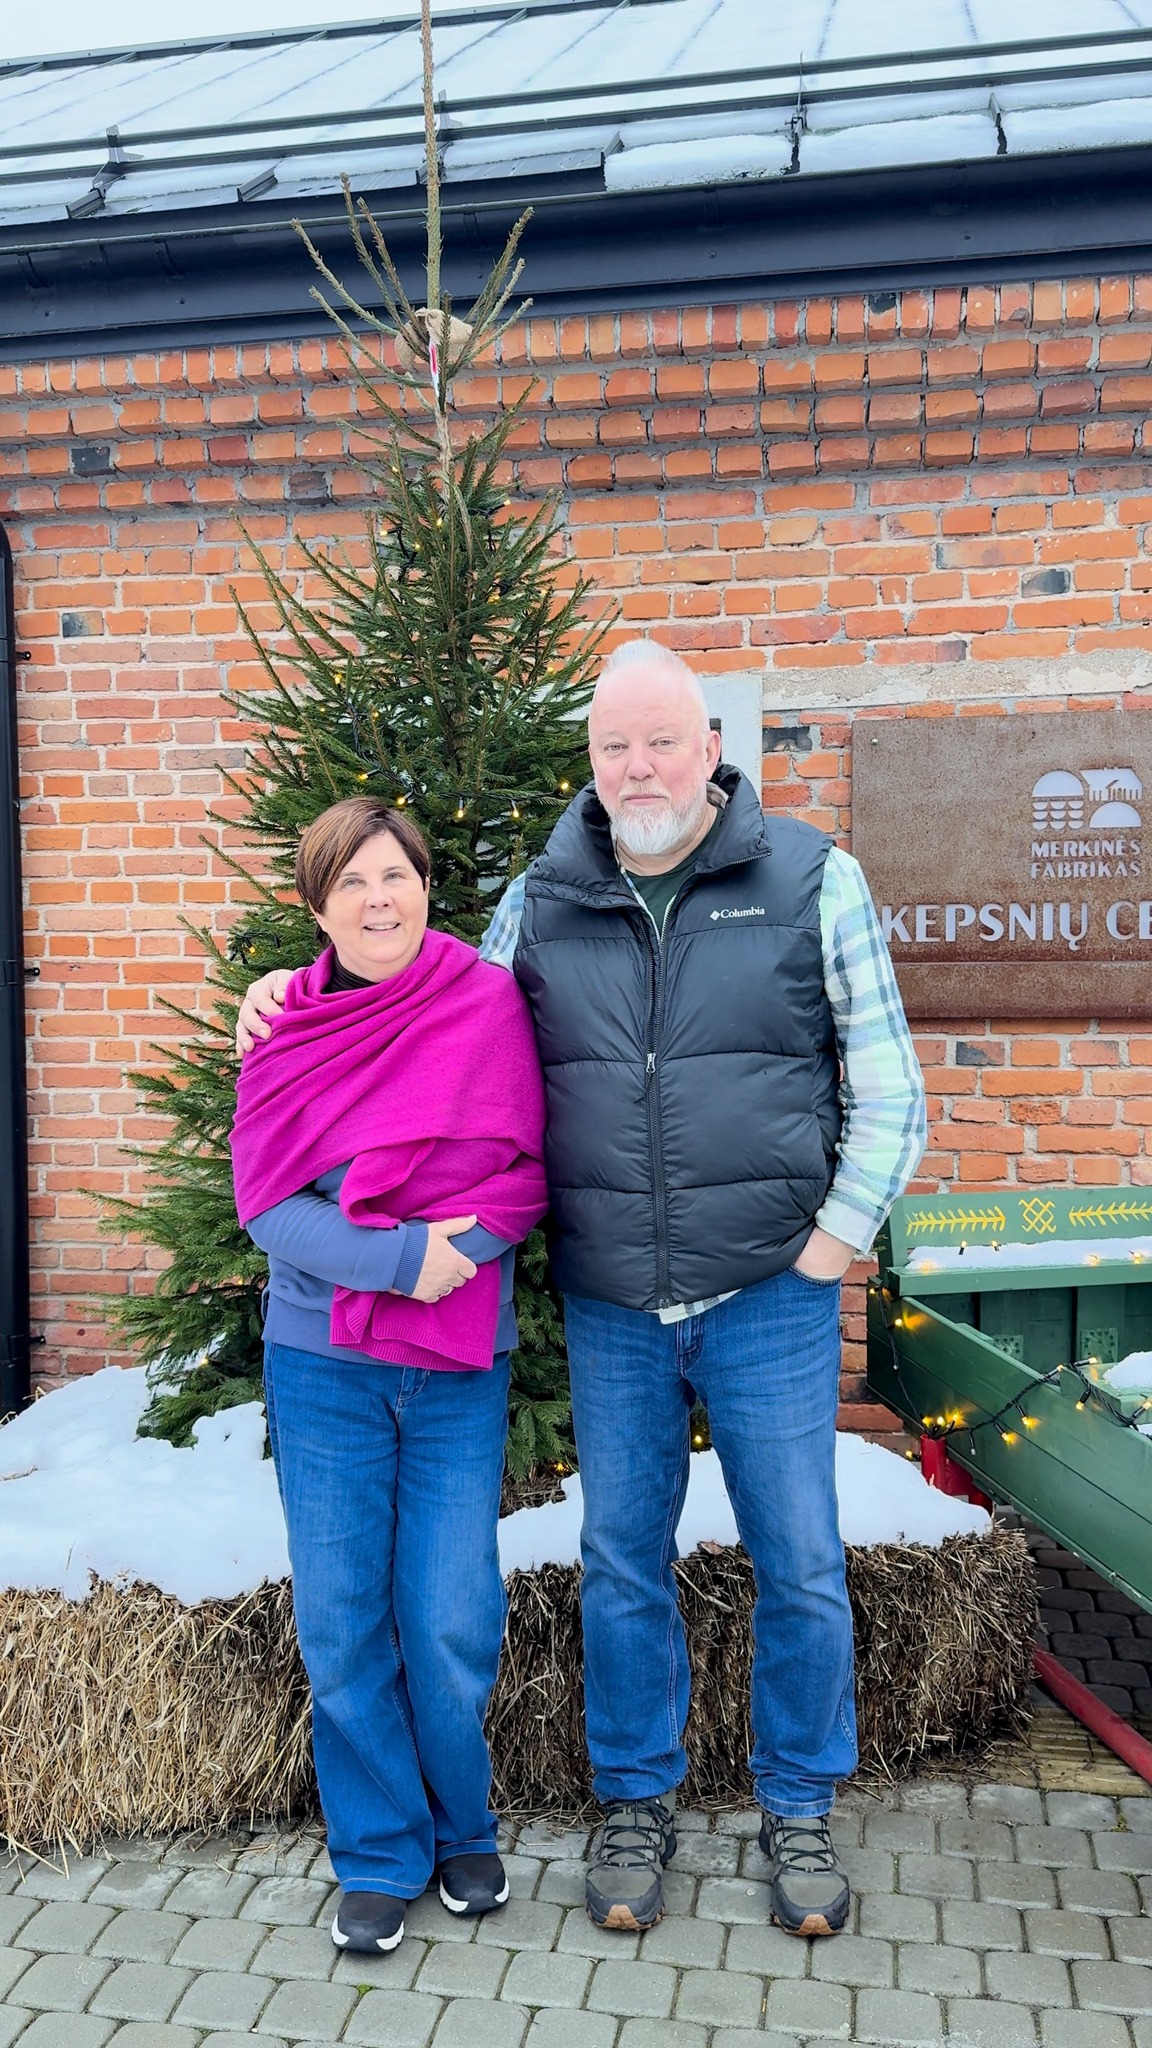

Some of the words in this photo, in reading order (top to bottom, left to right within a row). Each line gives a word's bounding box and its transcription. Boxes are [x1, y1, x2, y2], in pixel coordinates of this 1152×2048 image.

[1031, 836, 1141, 857] MERKINĖS
[1031, 860, 1141, 879] FABRIKAS
[720, 906, 765, 918] Columbia
[881, 902, 1088, 950] KEPSNIŲ
